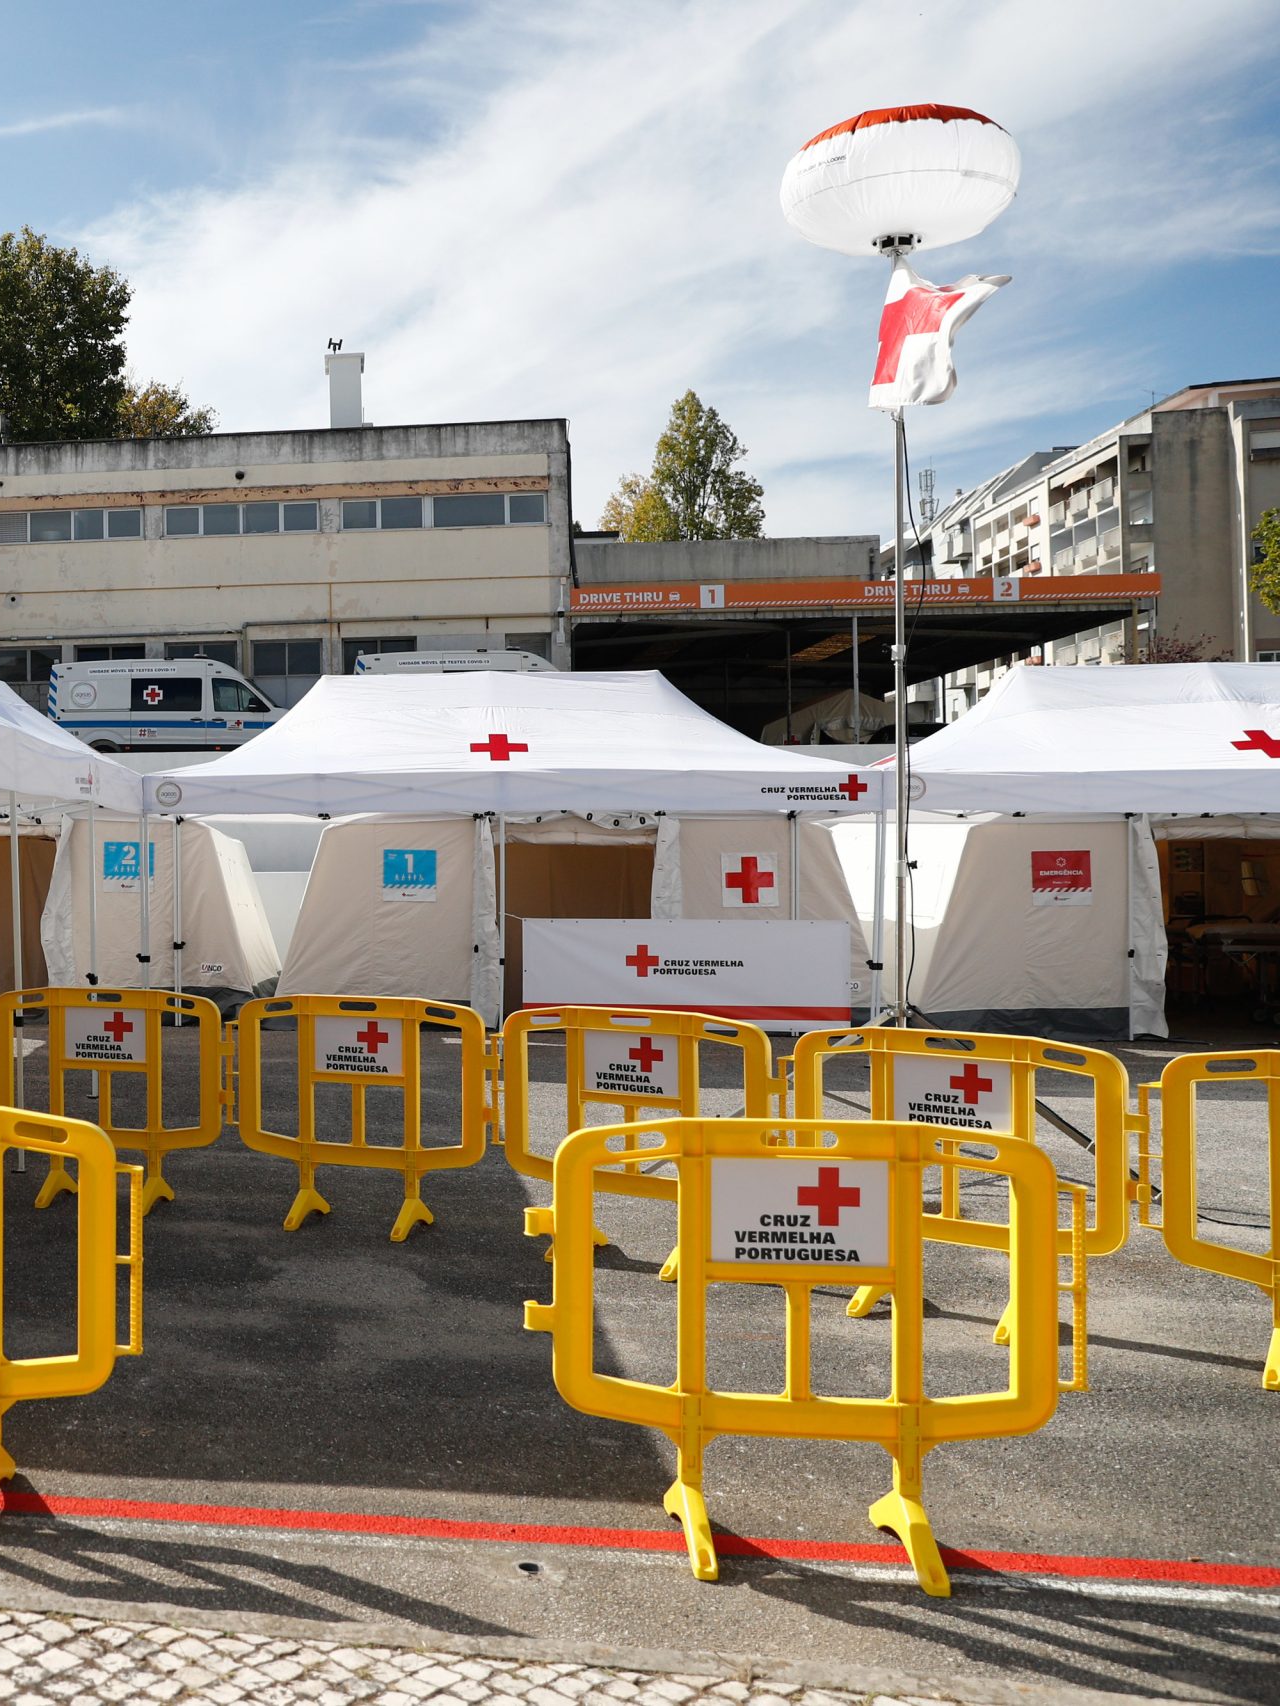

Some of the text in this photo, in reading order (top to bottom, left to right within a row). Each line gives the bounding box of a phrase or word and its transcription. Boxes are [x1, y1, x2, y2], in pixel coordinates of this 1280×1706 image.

[910, 584, 951, 595] THRU
[1000, 581, 1013, 597] 2
[580, 591, 663, 604] DRIVE THRU
[708, 589, 716, 604] 1
[761, 786, 786, 794] CRUZ
[121, 845, 136, 865] 2
[404, 854, 414, 873] 1
[663, 959, 744, 968] CRUZ VERMELHA
[653, 968, 717, 976] PORTUGUESA
[86, 1035, 111, 1043] CRUZ
[75, 1043, 122, 1051] VERMELHA
[338, 1045, 364, 1054] CRUZ
[75, 1051, 133, 1060] PORTUGUESA
[326, 1054, 376, 1063] VERMELHA
[326, 1063, 389, 1073] PORTUGUESA
[609, 1063, 637, 1072] CRUZ
[596, 1072, 650, 1083] VERMELHA
[596, 1082, 664, 1094] PORTUGUESA
[924, 1092, 959, 1104] CRUZ
[908, 1102, 976, 1117] VERMELHA
[908, 1113, 993, 1130] PORTUGUESA
[760, 1214, 811, 1227] CRUZ
[734, 1230, 836, 1244] VERMELHA
[735, 1247, 860, 1262] PORTUGUESA
